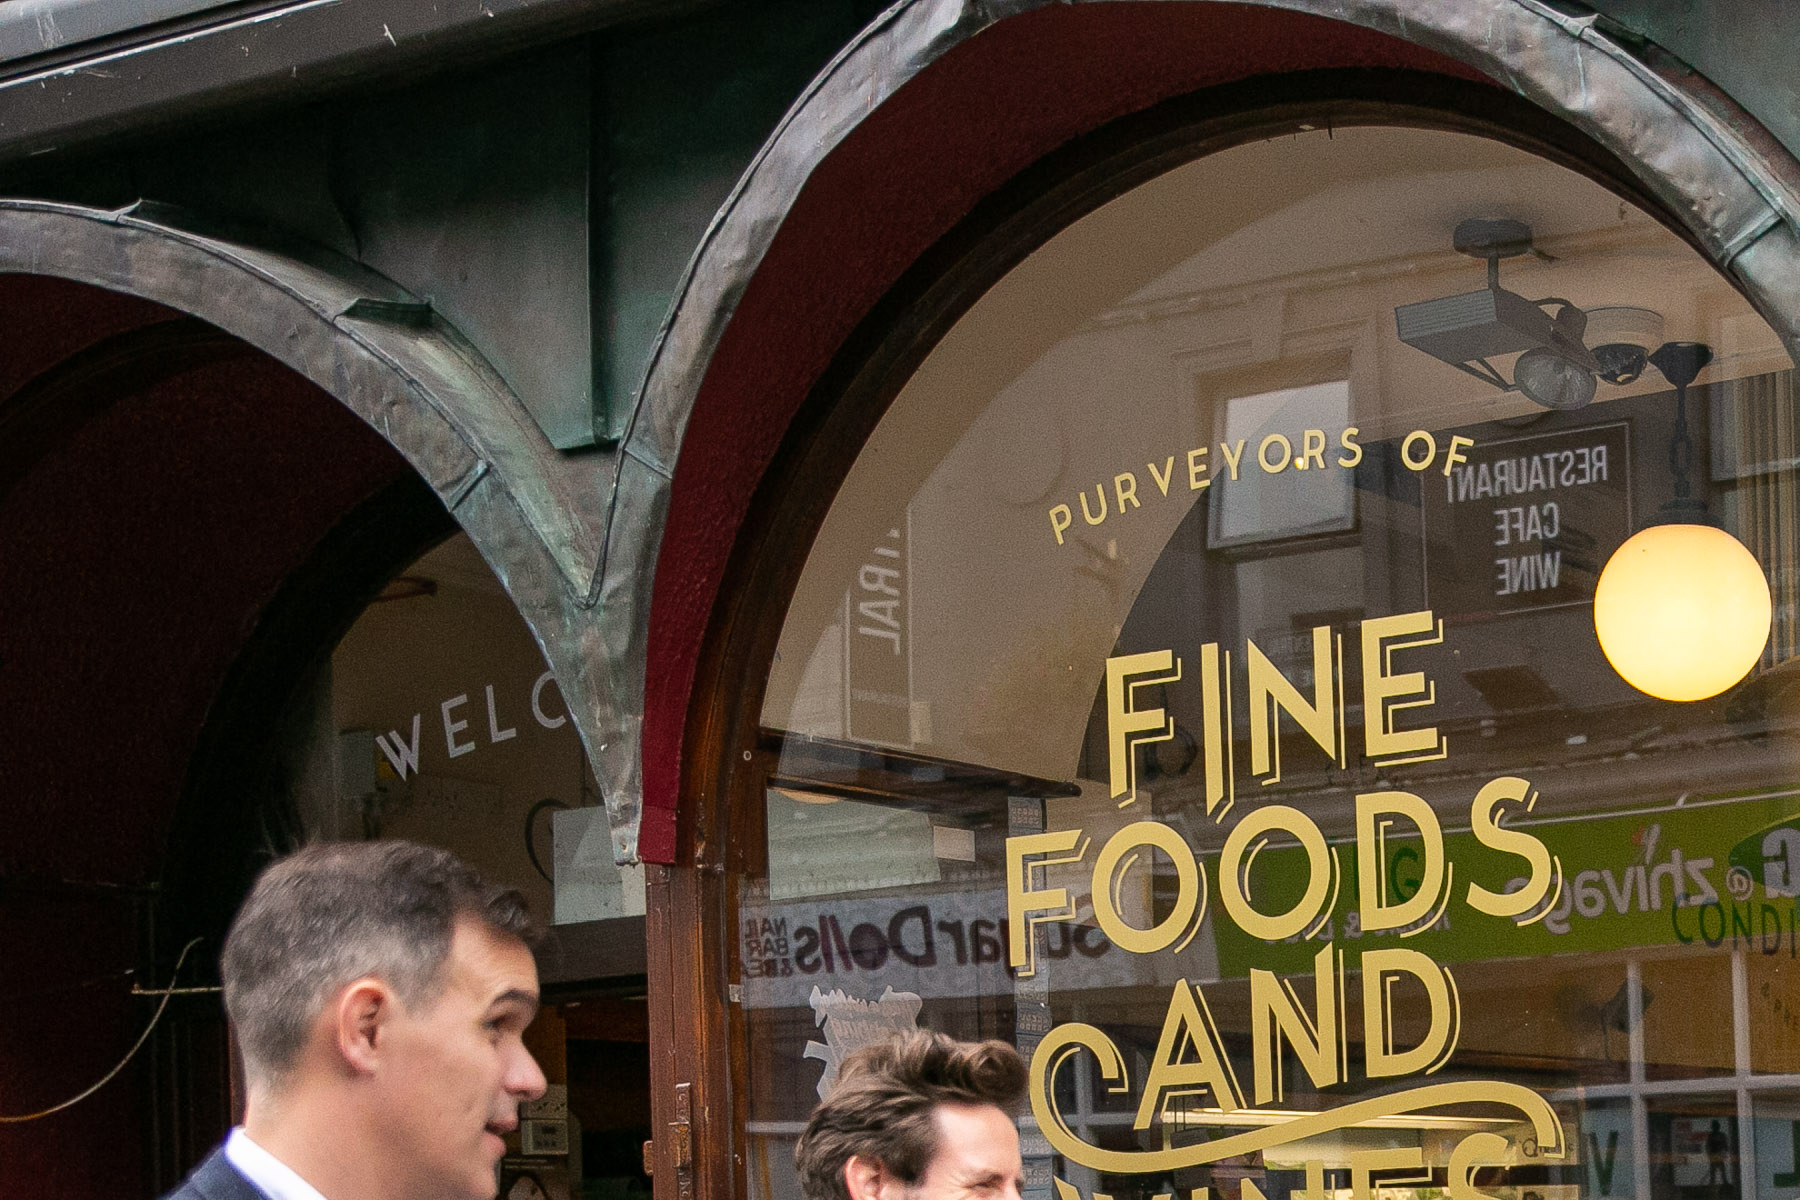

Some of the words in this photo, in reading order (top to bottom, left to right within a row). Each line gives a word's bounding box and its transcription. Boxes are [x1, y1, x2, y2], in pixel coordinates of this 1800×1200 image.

[1048, 427, 1363, 546] PURVEYORS
[1400, 429, 1475, 478] OF
[1105, 610, 1447, 823] FINE
[1003, 776, 1561, 978] FOODS
